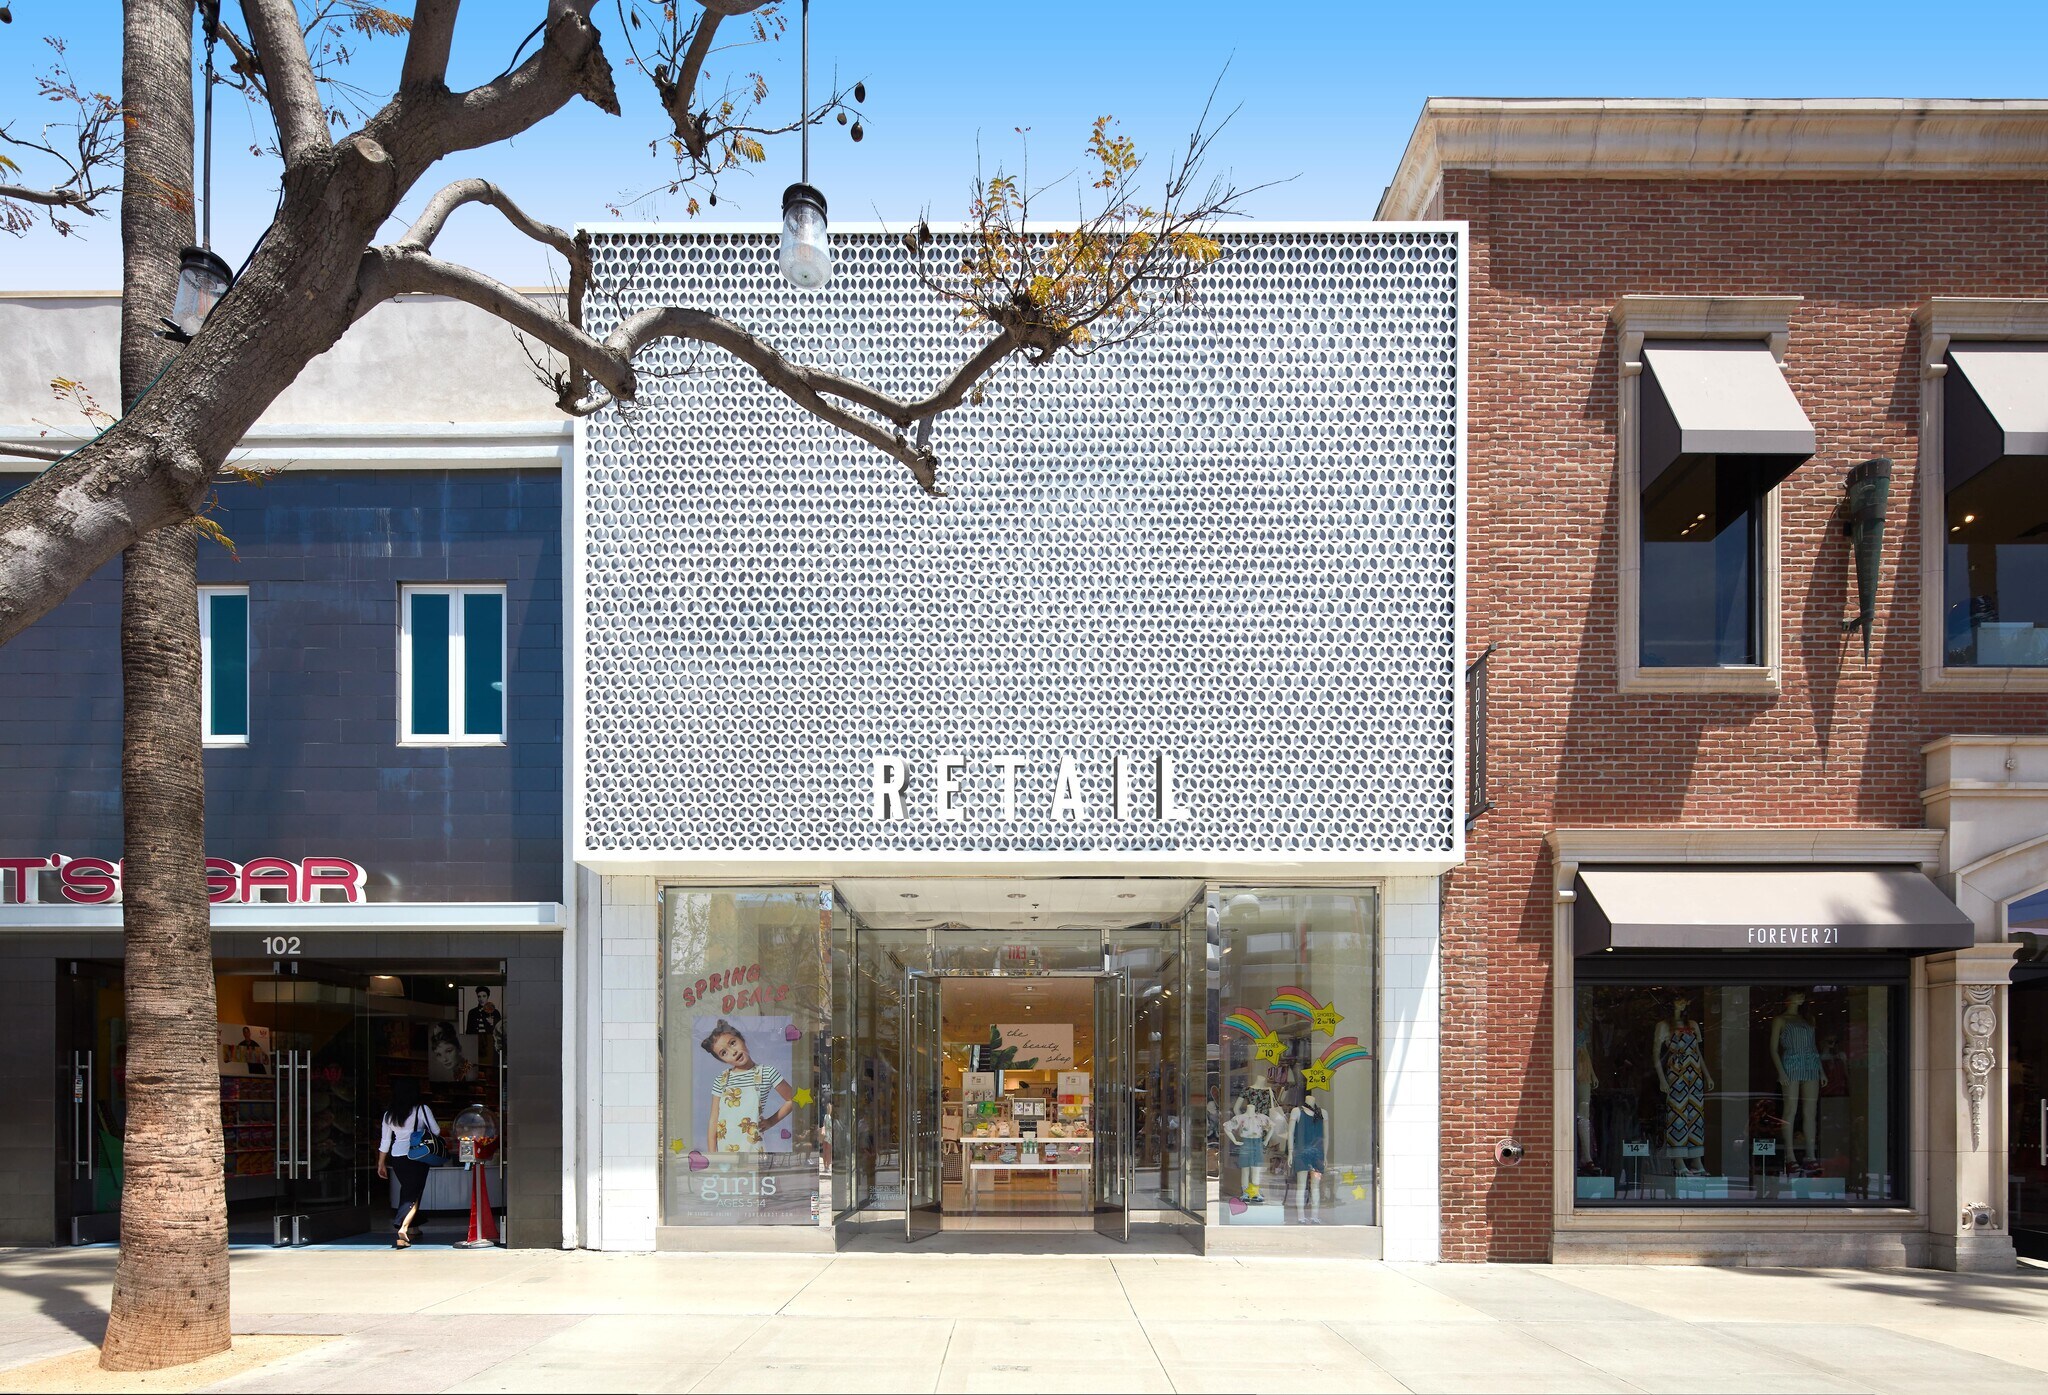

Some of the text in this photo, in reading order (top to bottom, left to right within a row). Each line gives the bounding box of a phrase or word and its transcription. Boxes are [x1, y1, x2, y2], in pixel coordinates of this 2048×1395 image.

[872, 754, 1193, 820] RETAIL
[1473, 787, 1482, 806] 21
[1748, 927, 1838, 944] FOREVER 21
[262, 936, 301, 955] 102
[682, 963, 761, 1008] SPRING
[721, 984, 790, 1015] DEALS
[1006, 1028, 1028, 1037] the
[1022, 1039, 1060, 1052] beauty
[700, 1162, 777, 1201] girls
[716, 1198, 744, 1208] AGES
